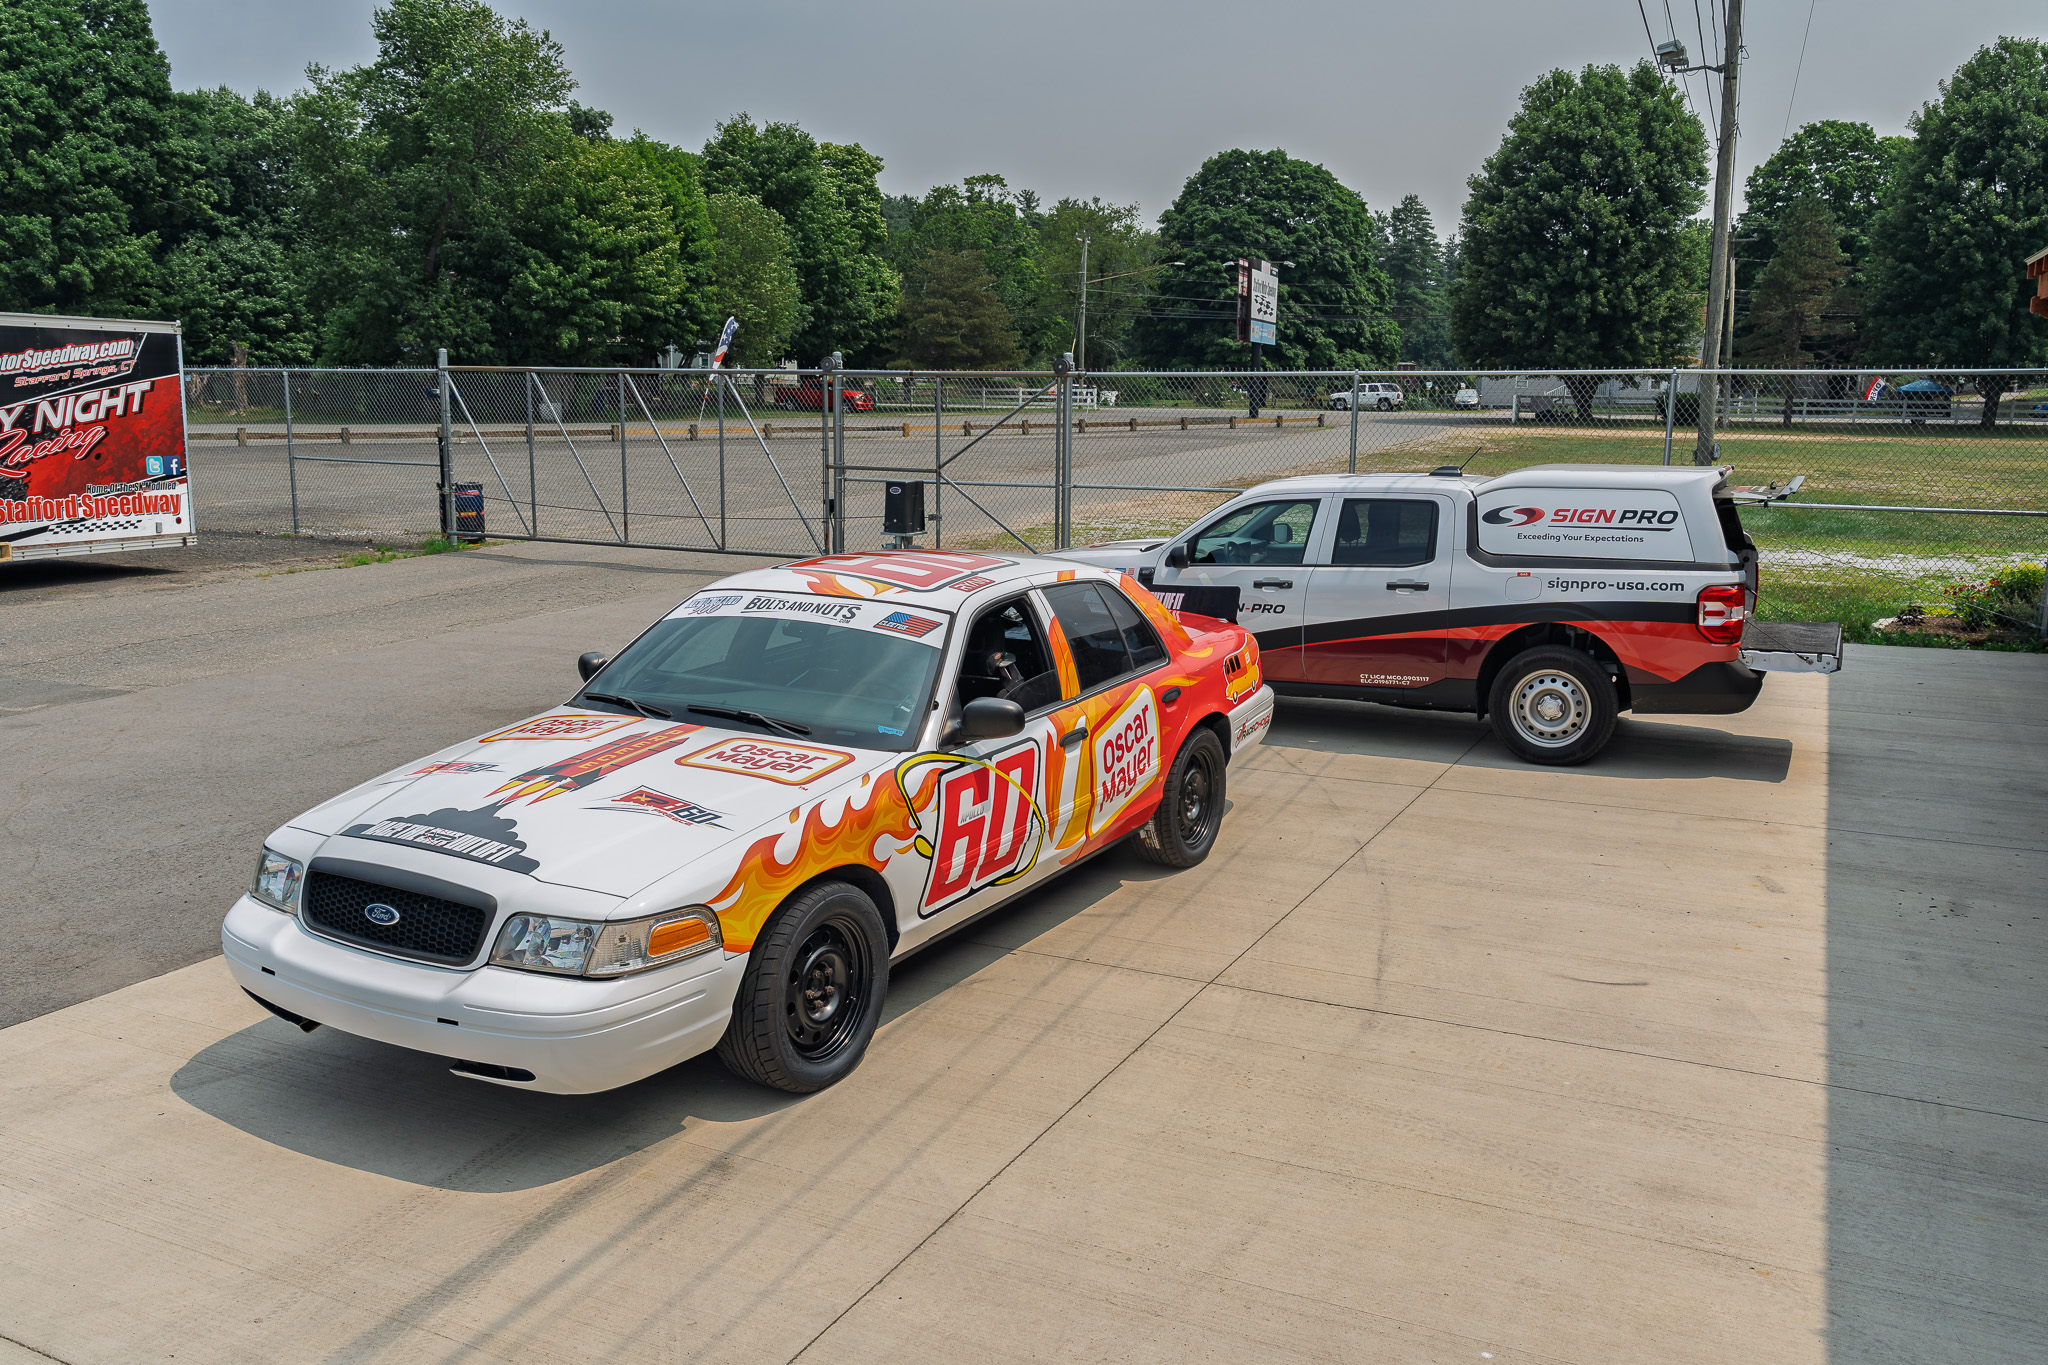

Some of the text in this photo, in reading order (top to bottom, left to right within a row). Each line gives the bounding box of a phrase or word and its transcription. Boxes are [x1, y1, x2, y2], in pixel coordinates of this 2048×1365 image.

[0, 340, 131, 371] torSpeedway.com
[14, 360, 137, 387] Stafford Springs, CT
[34, 382, 151, 433] NIGHT
[86, 484, 108, 494] Home
[120, 482, 132, 492] The
[0, 492, 181, 524] Stafford Speedway
[1550, 508, 1679, 525] SIGN PRO
[1517, 532, 1644, 543] Exceeding Your Expectations
[1547, 577, 1685, 592] signpro-usa.com
[743, 597, 862, 620] BOLTSANDNUTS
[507, 727, 603, 736] Mayer
[1103, 704, 1149, 774] Oscar
[578, 729, 685, 769] PREECE
[730, 744, 828, 764] Oscar
[704, 751, 813, 774] Mayer
[1099, 736, 1155, 813] Mayer
[925, 747, 1035, 908] 60
[371, 907, 391, 920] Ford
